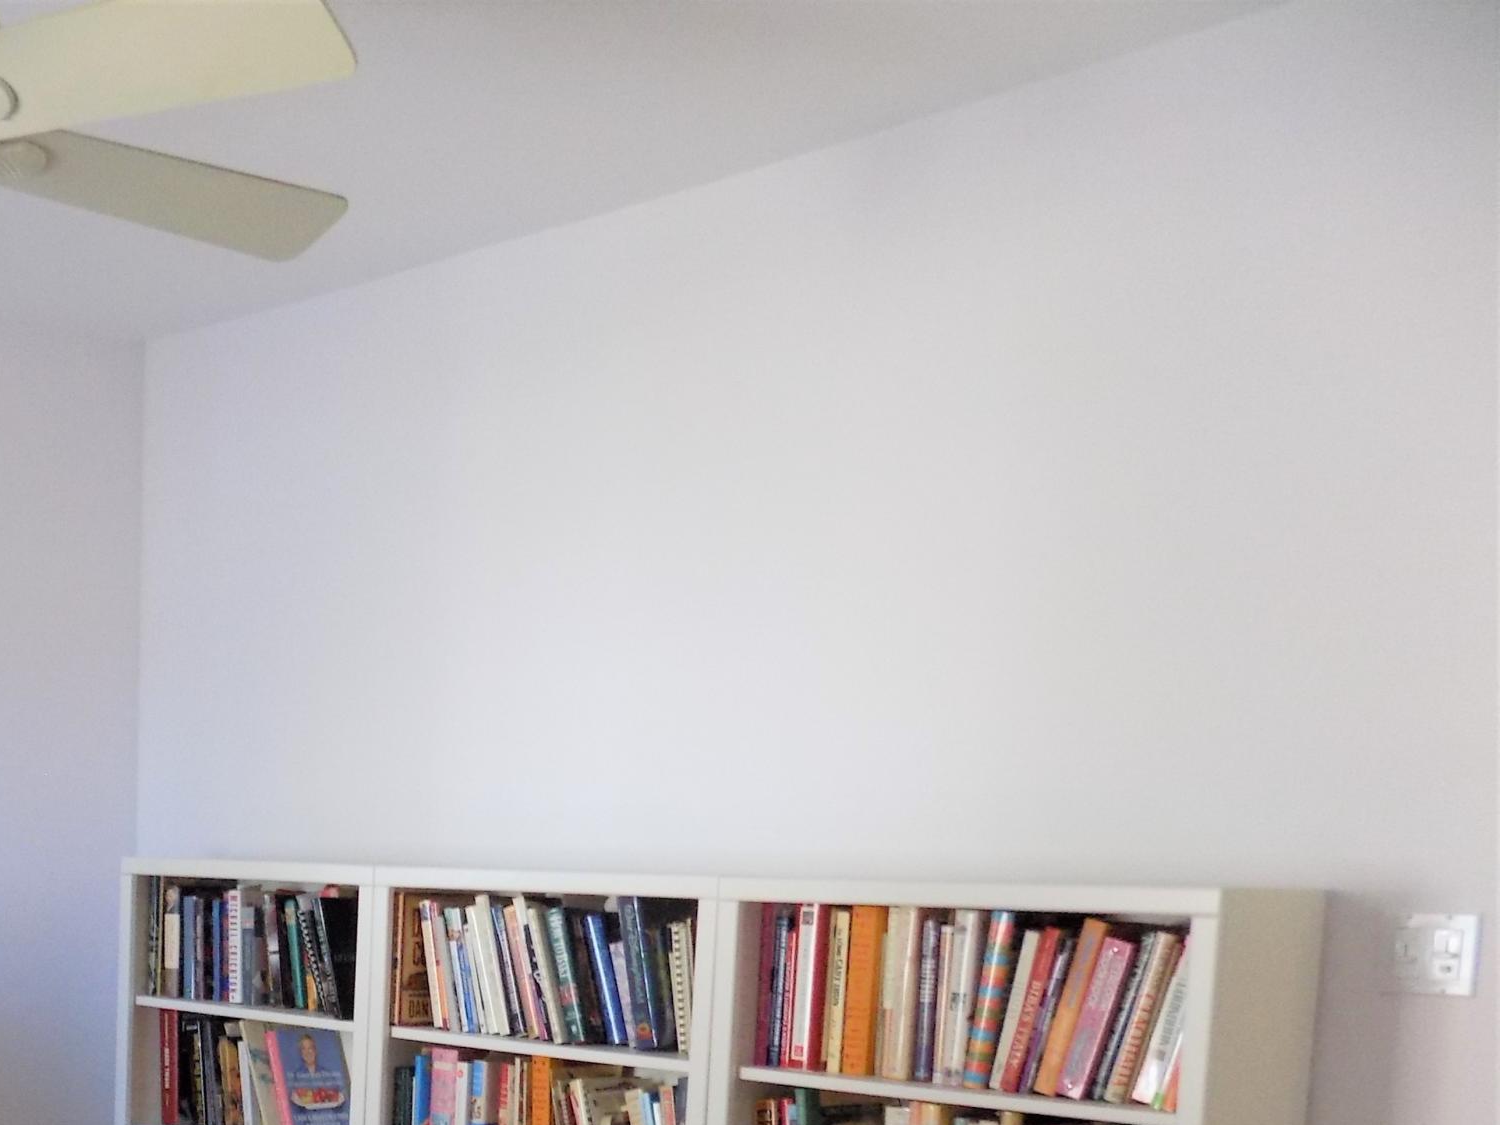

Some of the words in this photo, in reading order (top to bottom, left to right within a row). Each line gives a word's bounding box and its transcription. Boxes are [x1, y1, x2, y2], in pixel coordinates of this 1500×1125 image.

[230, 895, 238, 937] MICHAEL
[230, 945, 238, 993] CRICHTON
[1021, 979, 1043, 1023] BIBA'S
[1007, 1026, 1029, 1070] ITALY
